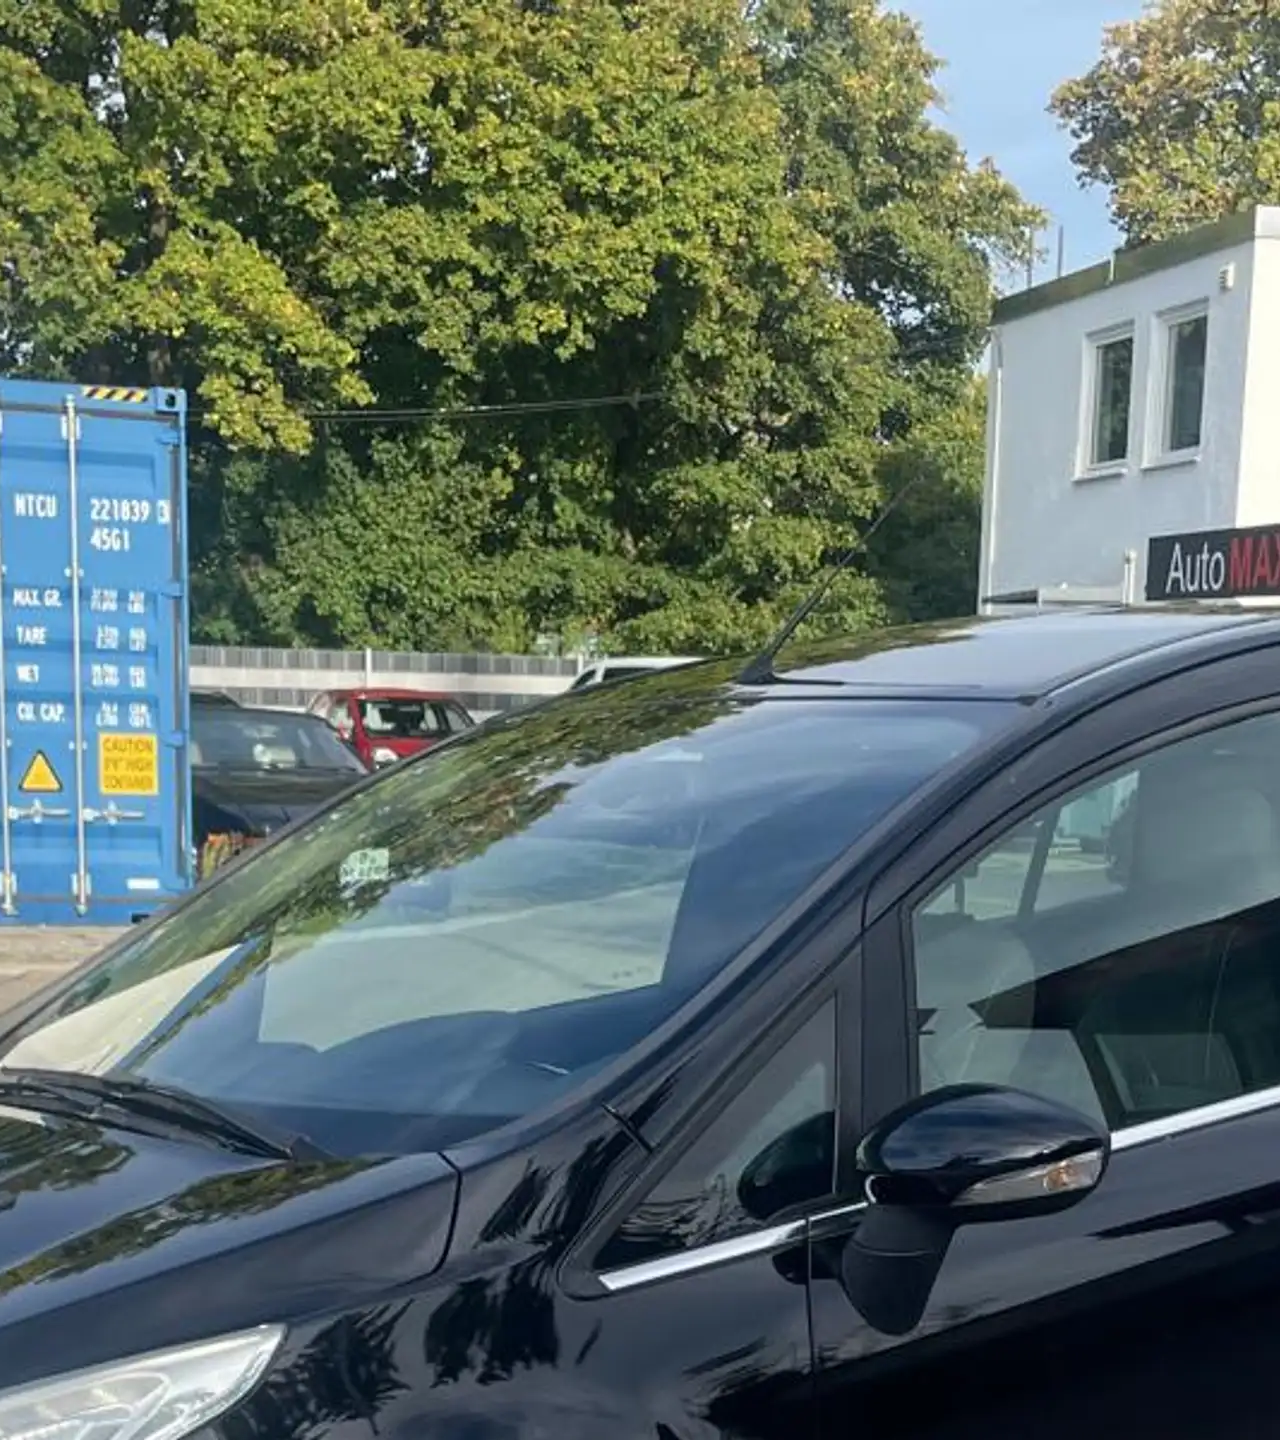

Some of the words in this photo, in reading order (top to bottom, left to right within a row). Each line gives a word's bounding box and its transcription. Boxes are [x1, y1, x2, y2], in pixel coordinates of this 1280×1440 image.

[90, 498, 150, 523] 221839
[90, 527, 131, 552] 45G1
[1166, 541, 1225, 594] Auto
[103, 738, 153, 753] CAUTION
